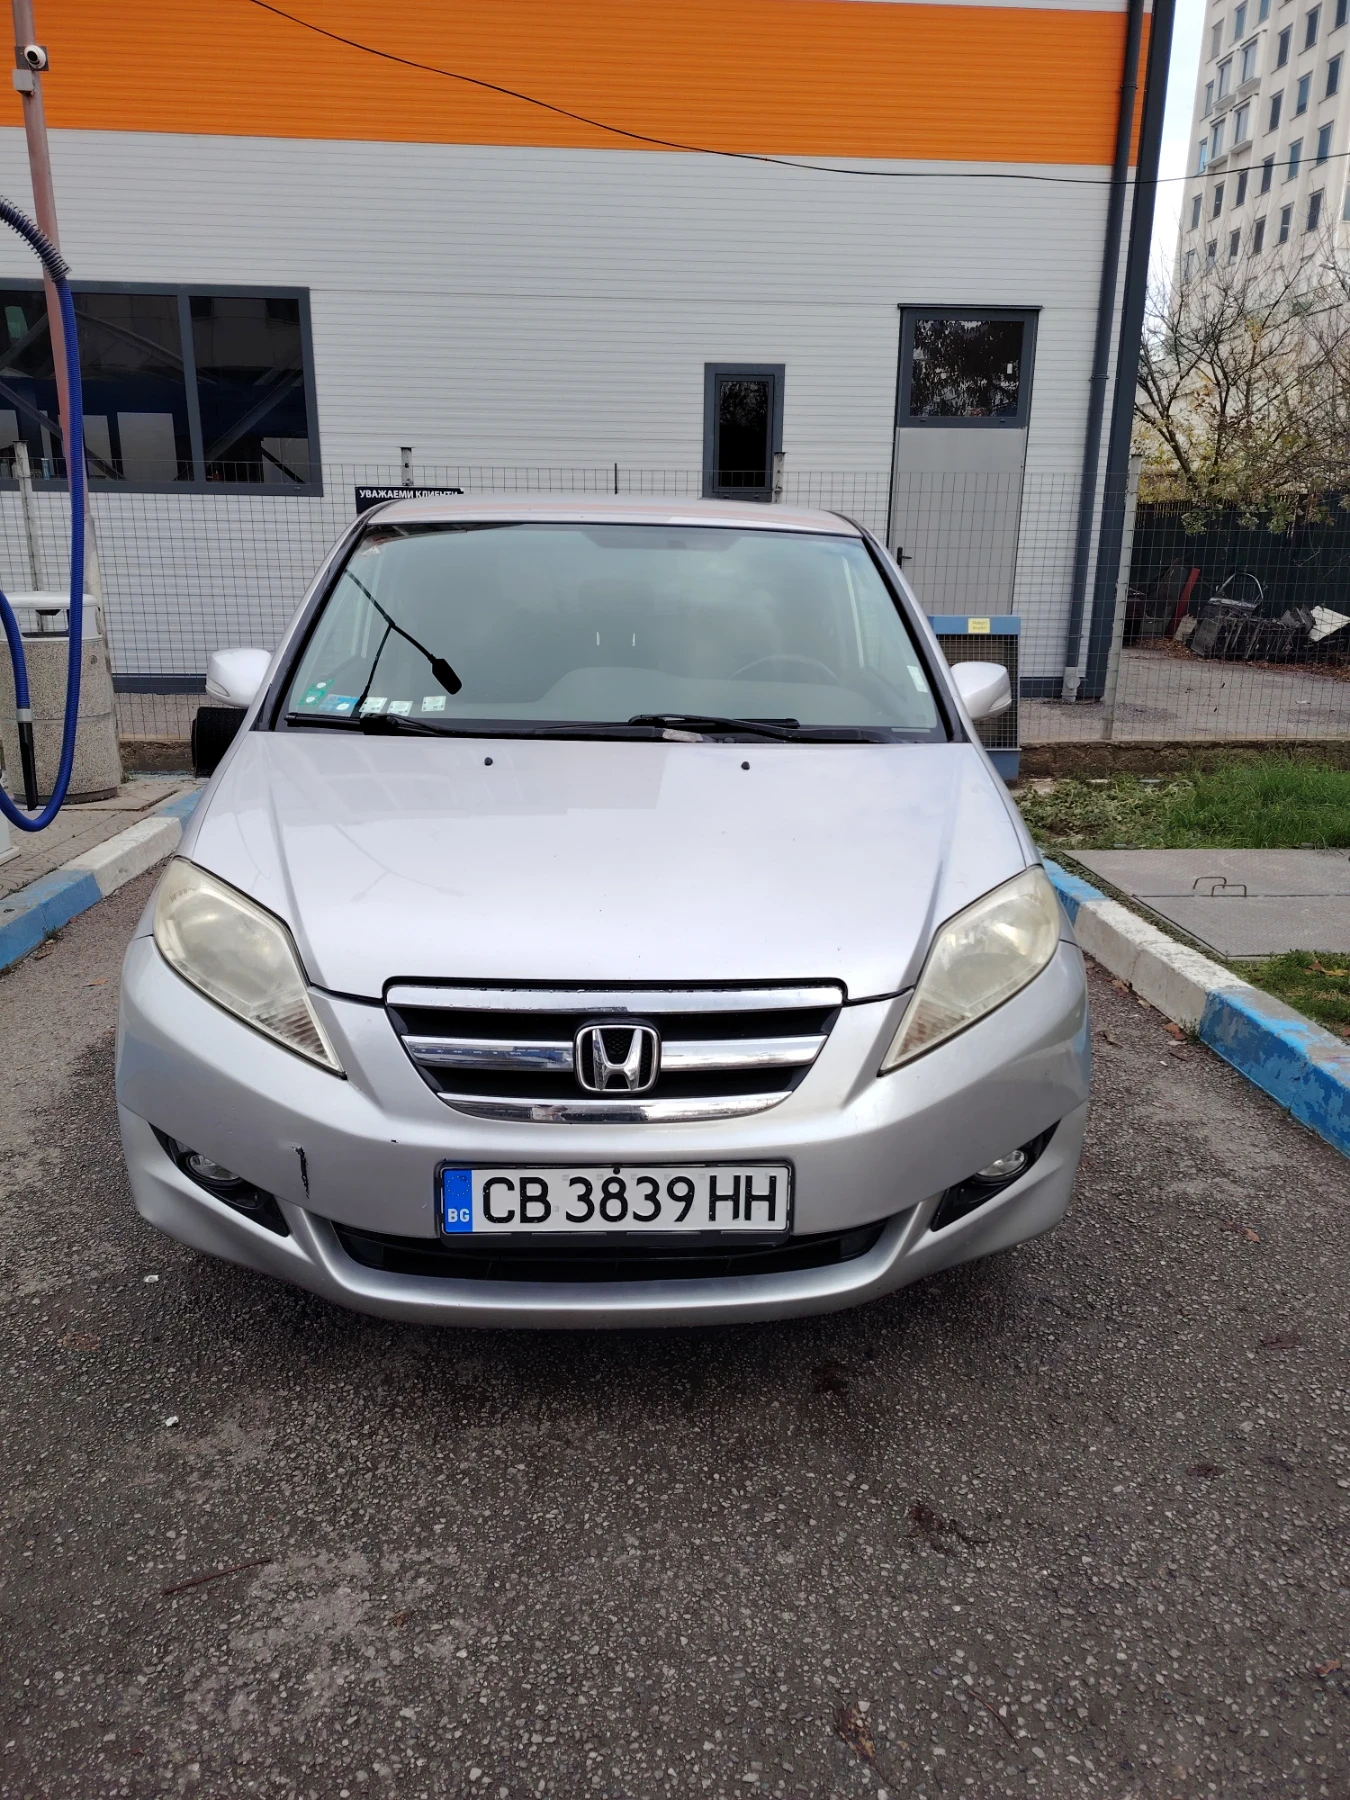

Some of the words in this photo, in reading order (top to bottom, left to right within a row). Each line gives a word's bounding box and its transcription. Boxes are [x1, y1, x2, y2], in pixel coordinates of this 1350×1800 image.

[359, 489, 414, 499] УВАЖАЕМИ
[565, 1175, 696, 1223] 3839
[447, 1208, 470, 1223] BG
